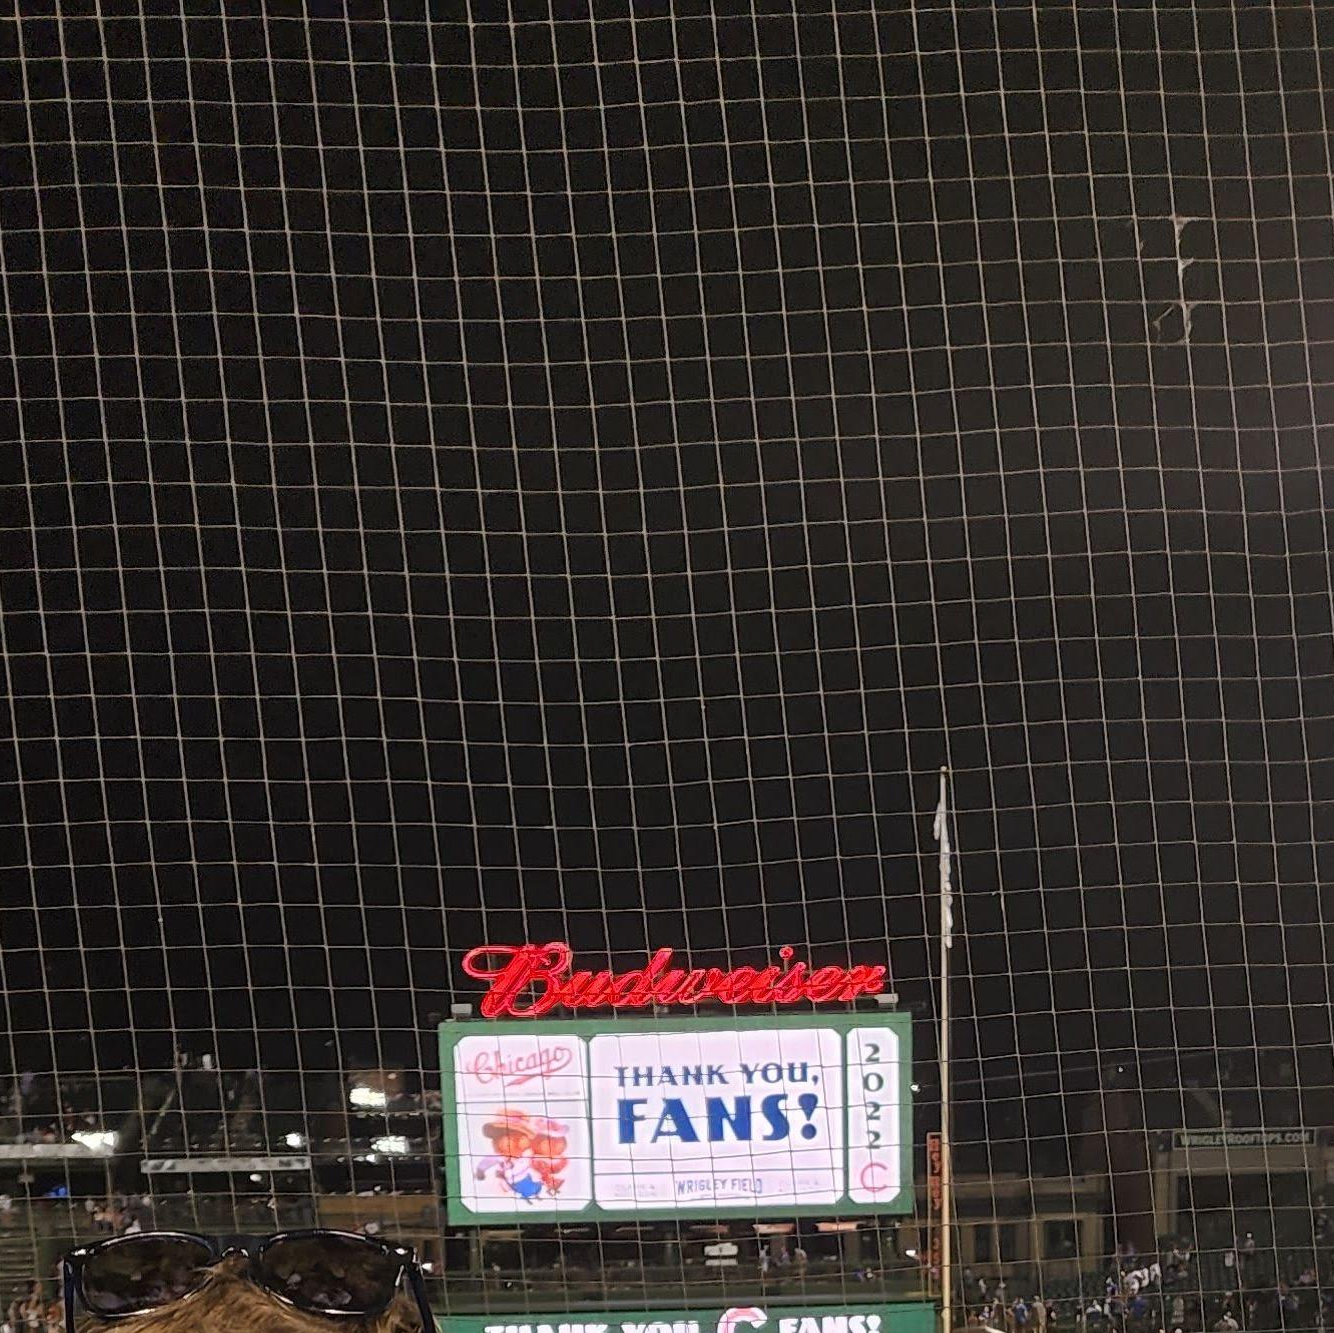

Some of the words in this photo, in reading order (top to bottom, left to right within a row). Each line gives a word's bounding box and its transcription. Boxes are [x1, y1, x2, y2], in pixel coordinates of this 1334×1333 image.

[462, 942, 887, 1018] Budweiser
[466, 1046, 573, 1088] Chicago
[615, 1064, 729, 1087] THANK
[739, 1062, 819, 1086] YOU,
[618, 1093, 819, 1144] FANS!
[676, 1178, 727, 1195] WRIGLEY
[731, 1177, 763, 1194] FIELD
